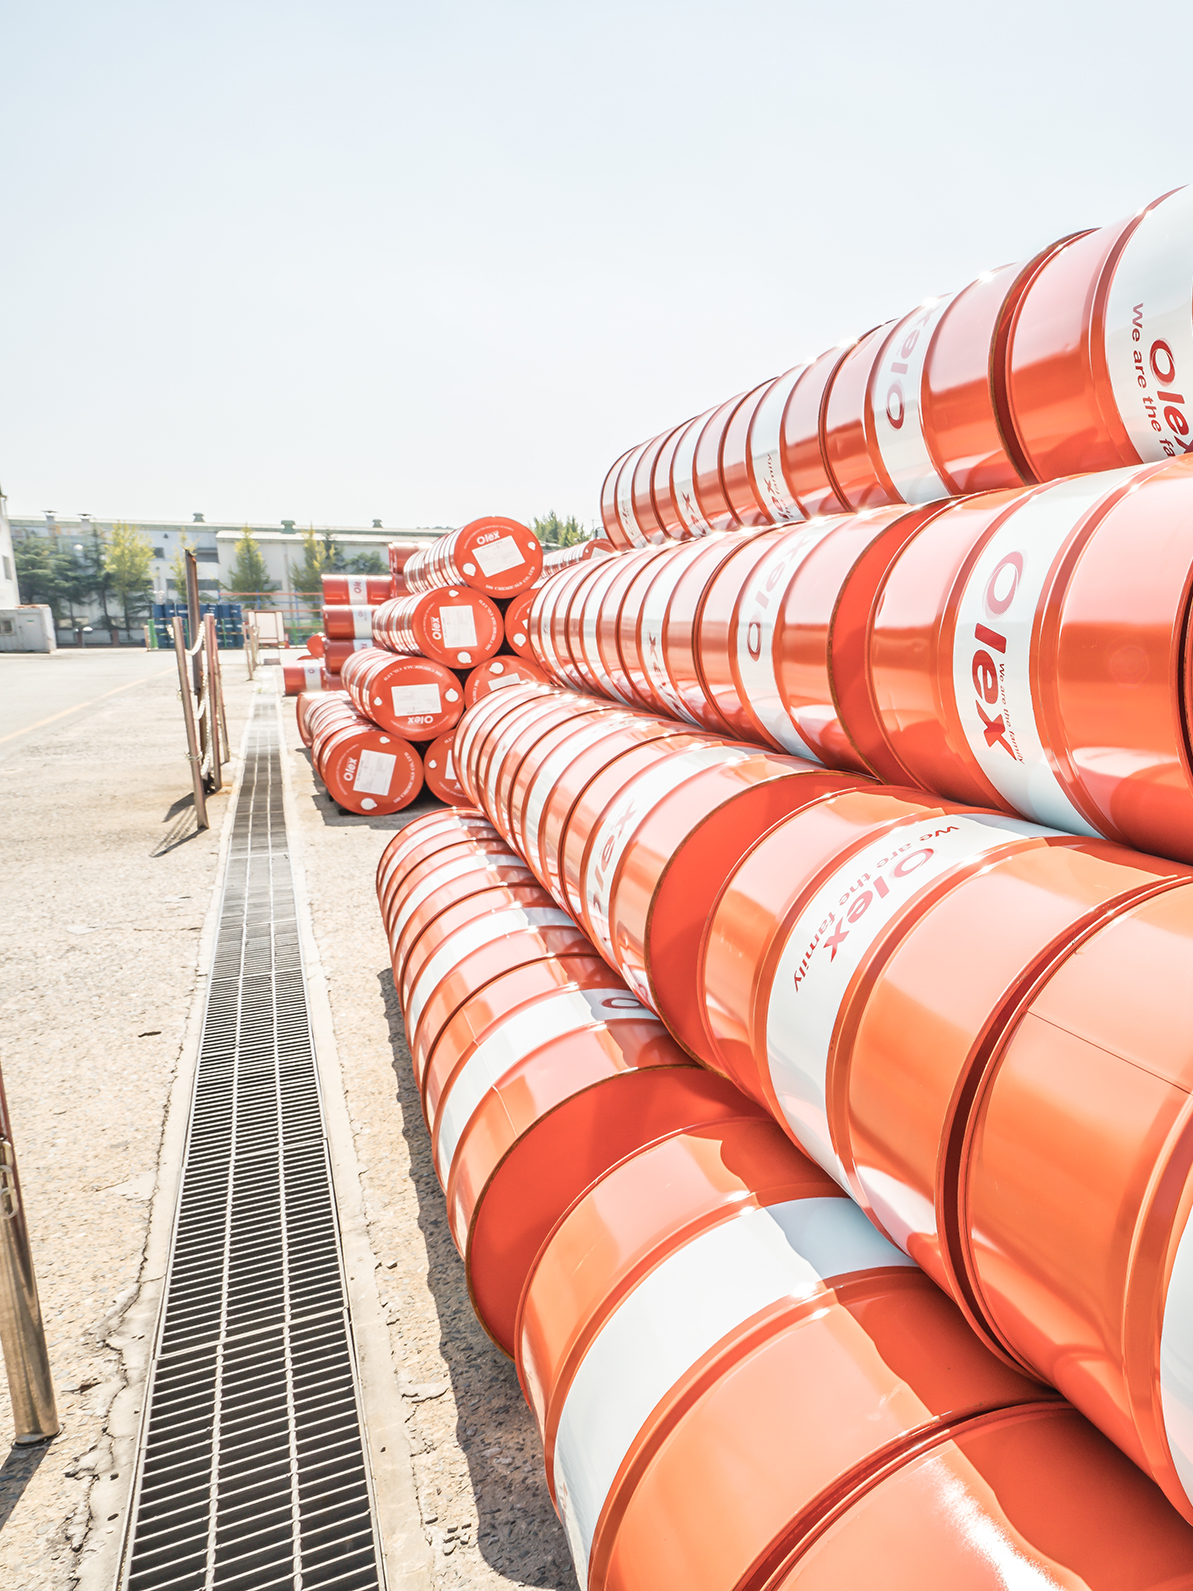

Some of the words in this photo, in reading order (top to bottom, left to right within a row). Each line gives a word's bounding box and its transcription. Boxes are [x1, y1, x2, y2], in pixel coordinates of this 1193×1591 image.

[1132, 303, 1144, 342] We
[1132, 350, 1147, 389] are
[1143, 396, 1162, 432] the
[477, 530, 500, 545] Olex
[430, 616, 442, 640] Olex
[971, 550, 1025, 762] Olex
[407, 715, 434, 725] Olex
[999, 663, 1005, 682] We
[1004, 708, 1012, 728] the
[1009, 730, 1025, 765] family
[343, 757, 357, 781] Olex
[919, 825, 960, 842] We
[876, 842, 912, 869] are
[823, 848, 936, 963] Olex
[838, 872, 871, 906] the
[793, 911, 837, 993] family
